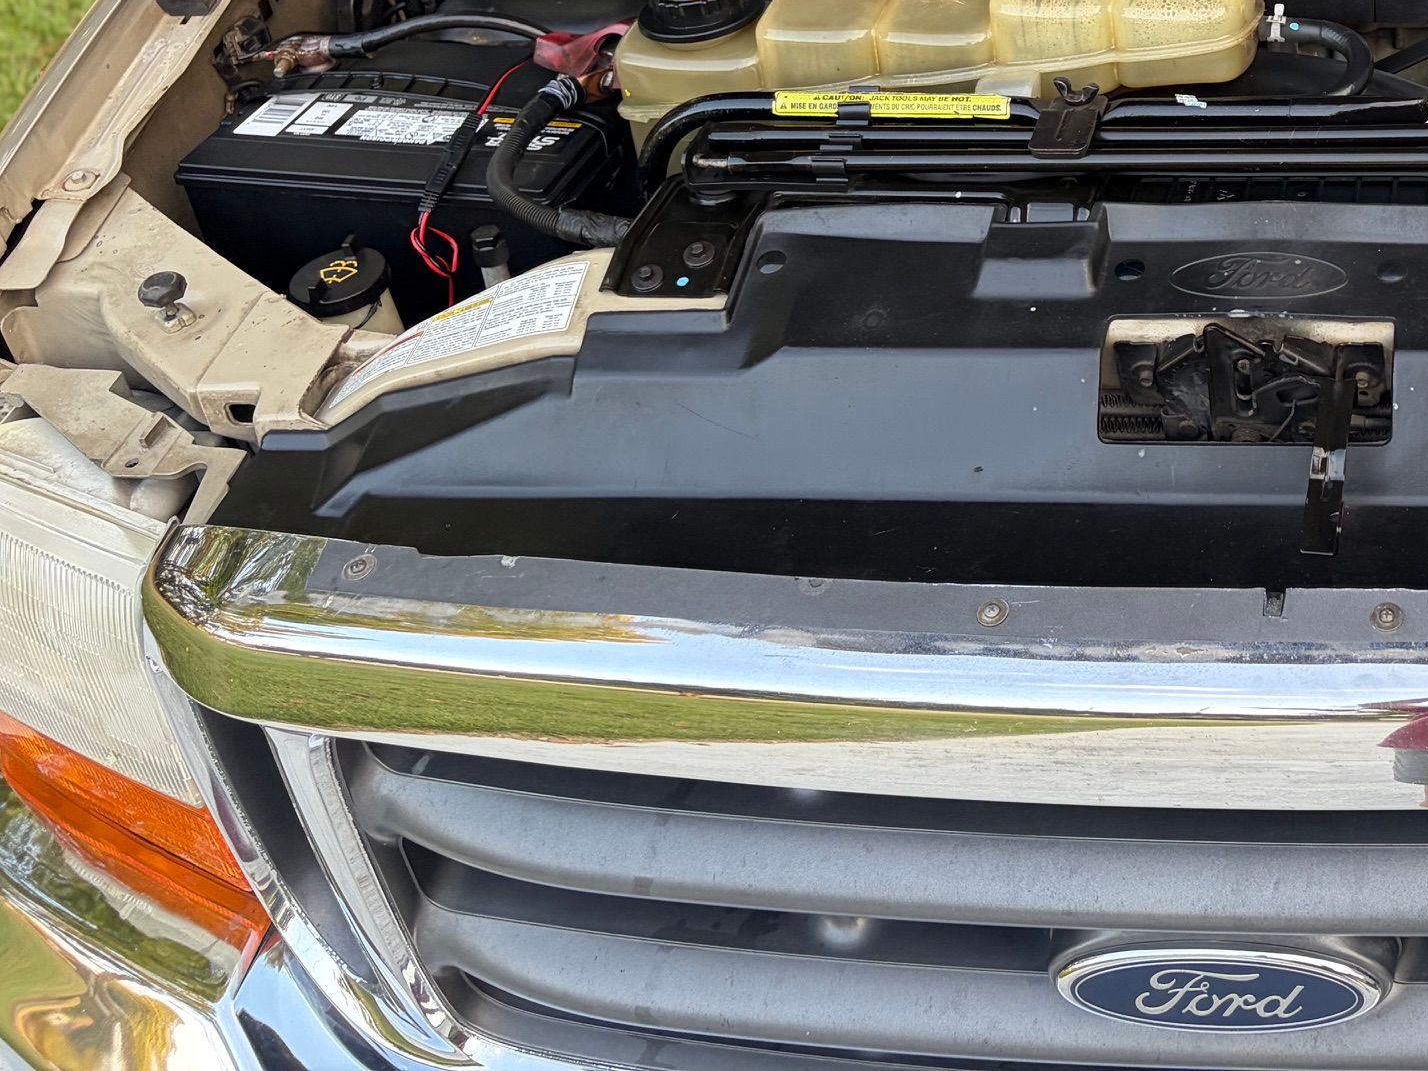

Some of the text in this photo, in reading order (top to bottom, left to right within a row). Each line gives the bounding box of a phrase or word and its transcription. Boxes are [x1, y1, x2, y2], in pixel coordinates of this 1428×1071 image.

[790, 102, 807, 110] MISE
[808, 102, 818, 110] EN
[972, 104, 1002, 112] CHAUDS.
[1203, 256, 1314, 291] Ford
[1134, 967, 1304, 1020] Ford
